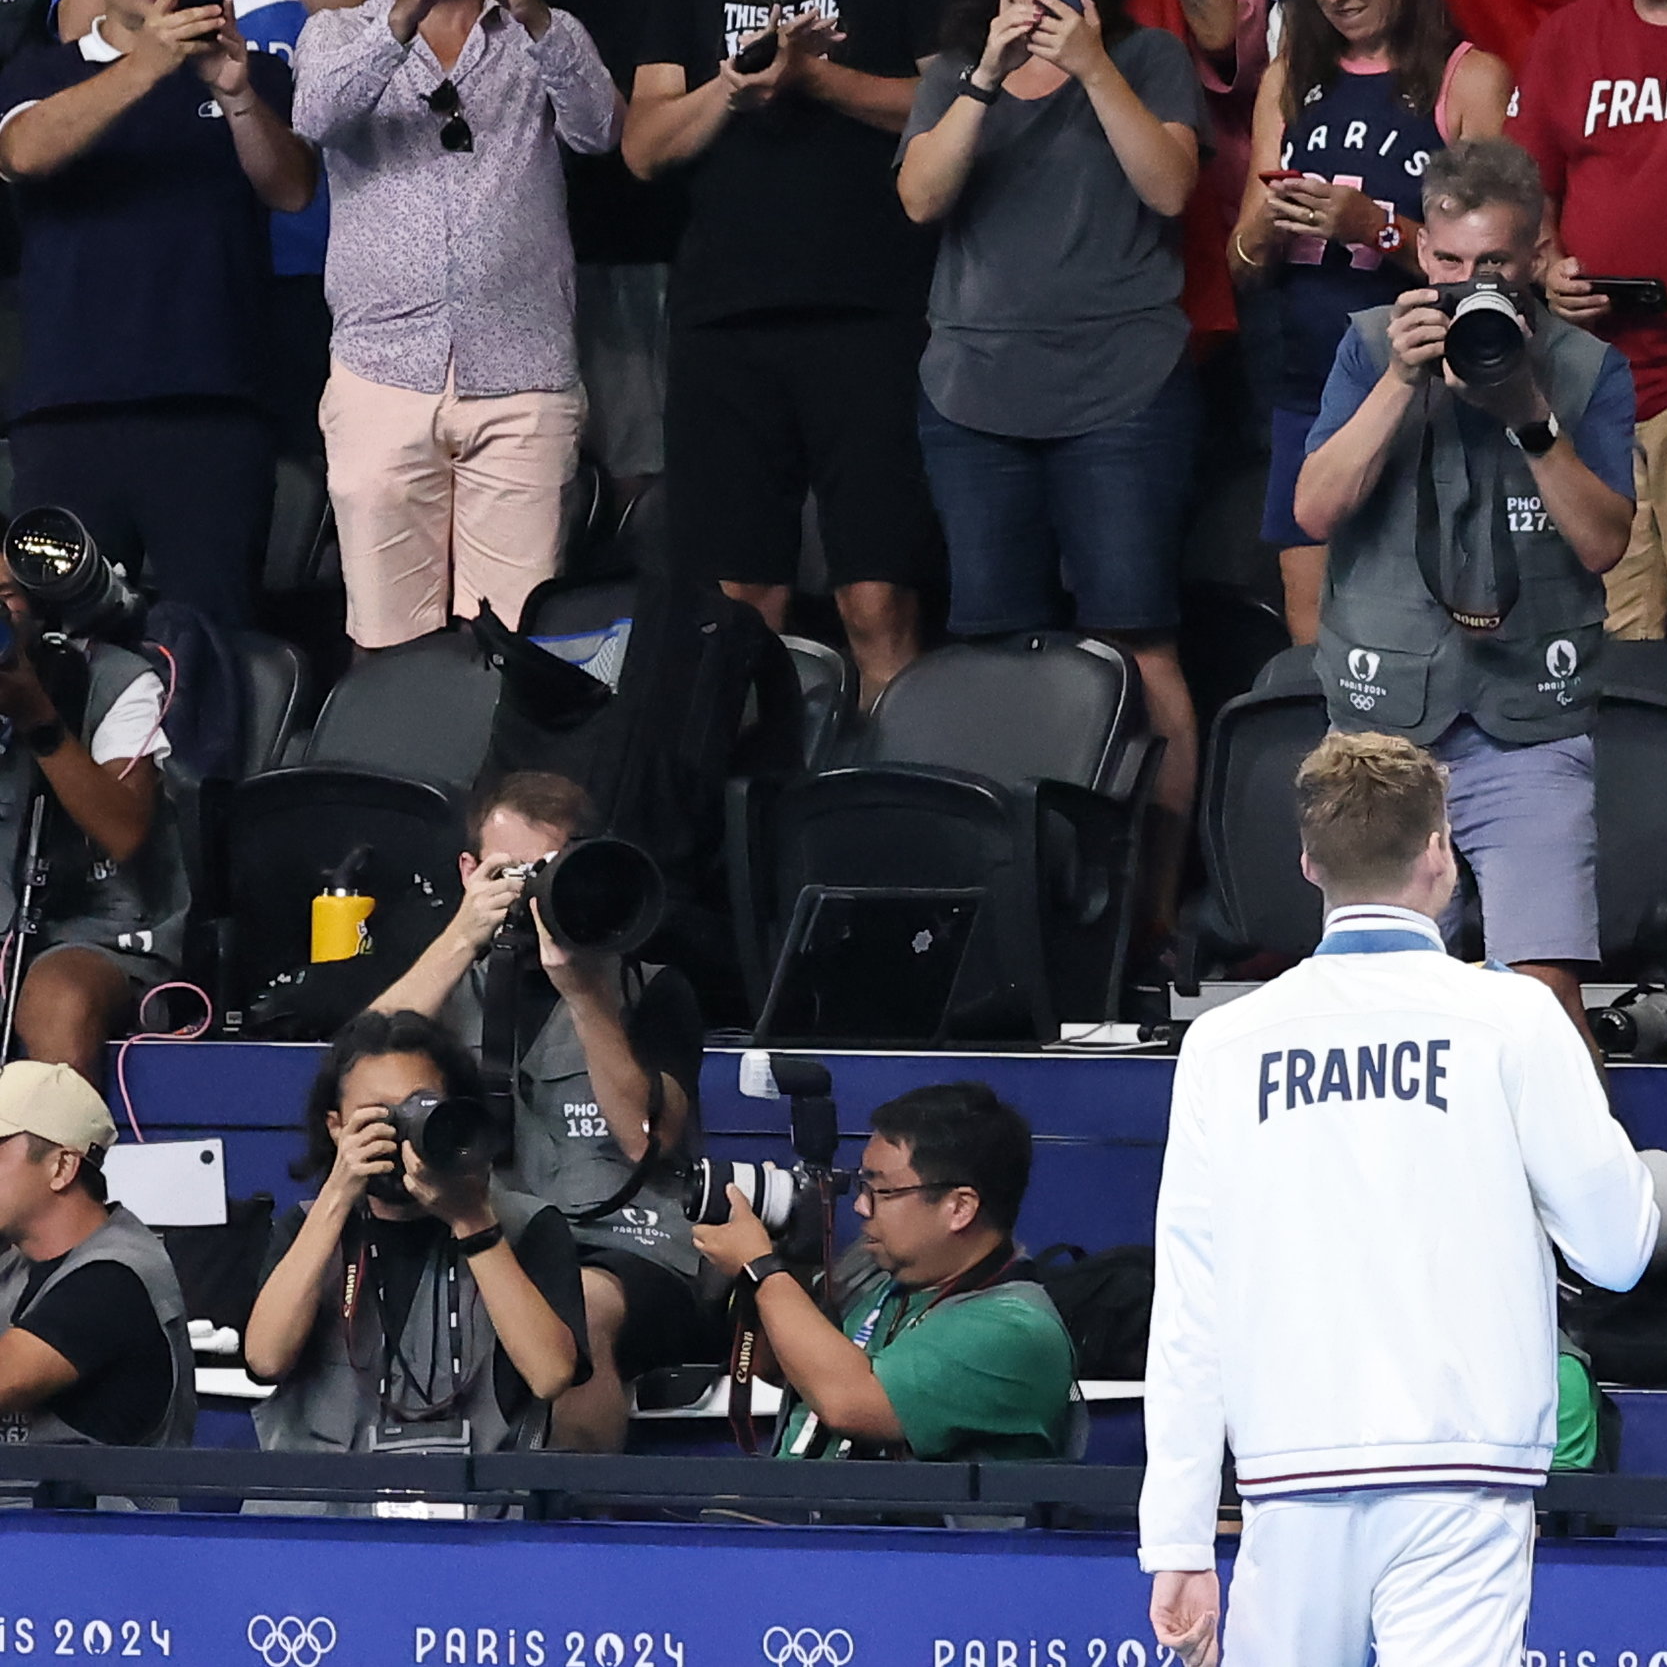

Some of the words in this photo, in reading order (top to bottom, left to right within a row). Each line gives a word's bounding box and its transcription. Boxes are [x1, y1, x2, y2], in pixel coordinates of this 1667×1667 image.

[725, 2, 770, 32] THIS
[1506, 497, 1541, 512] PHO
[1258, 1039, 1451, 1125] FRANCE
[563, 1103, 599, 1118] PHO
[566, 1117, 609, 1138] 182
[343, 1264, 356, 1318] Canon
[736, 1331, 754, 1384] Canon
[54, 1618, 171, 1656] 2024
[564, 1631, 684, 1667] 2024
